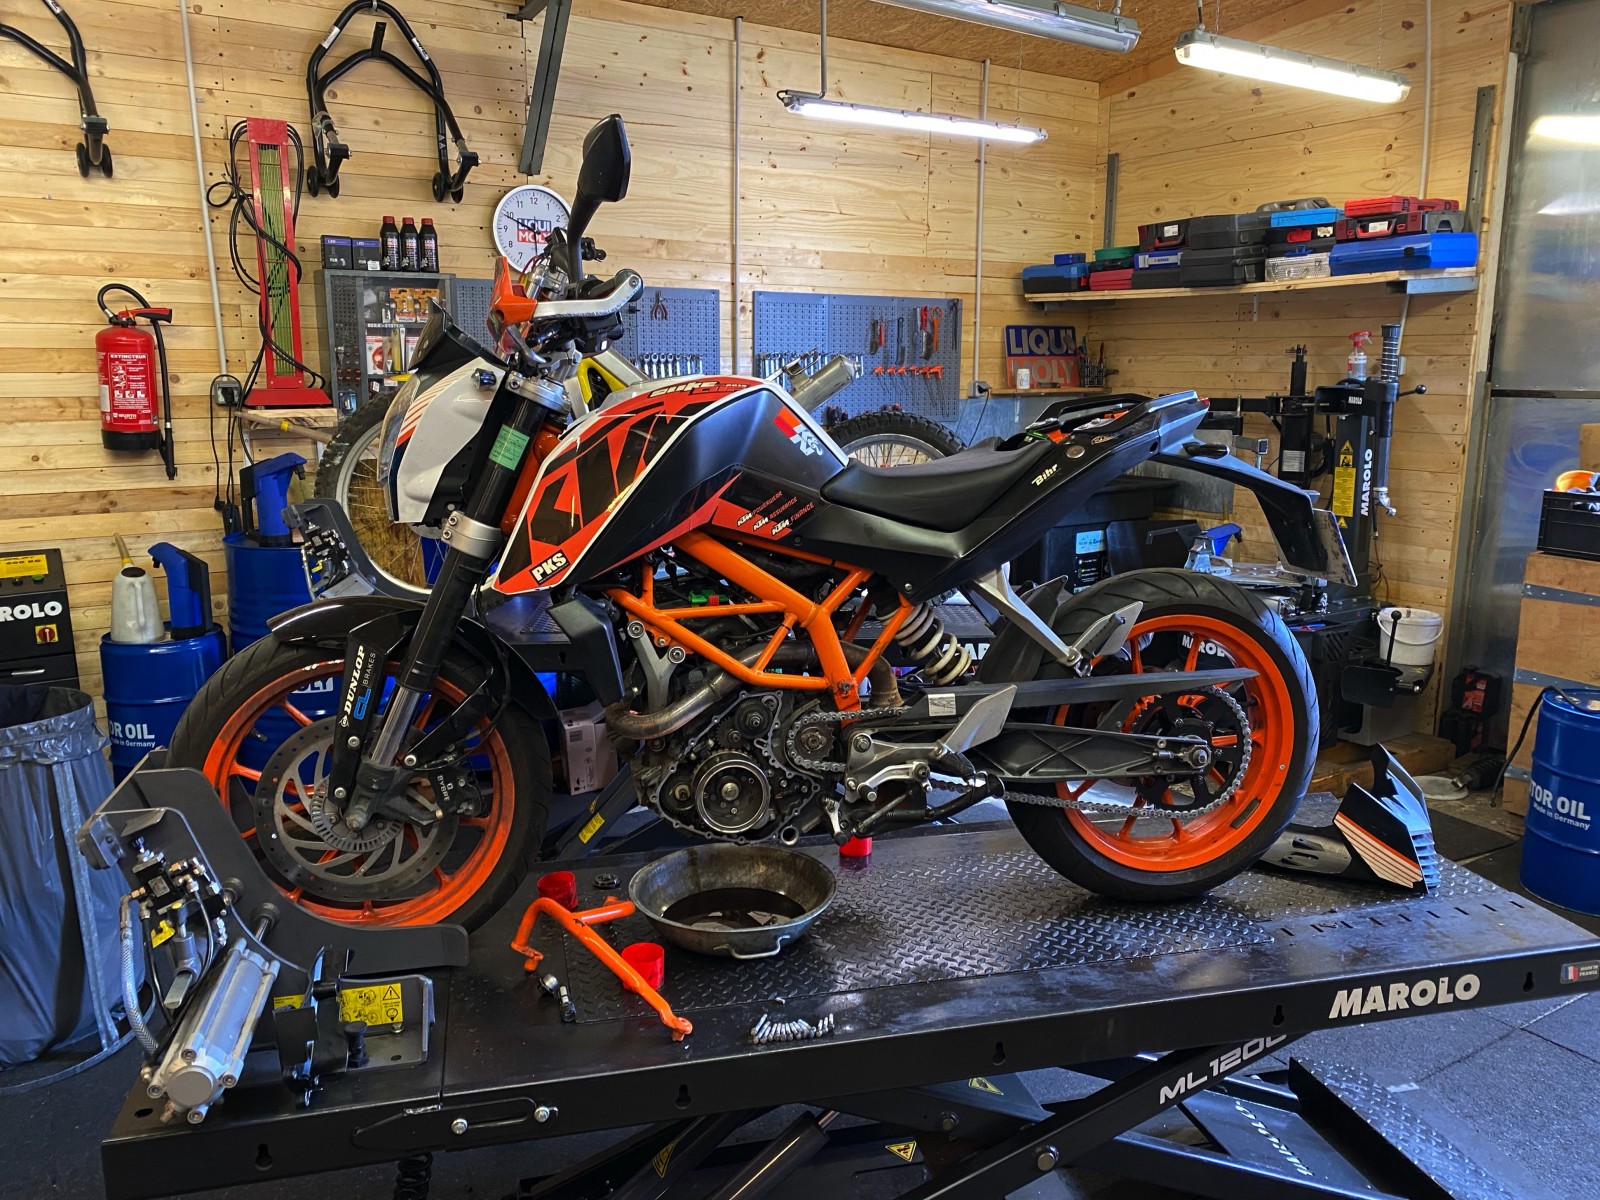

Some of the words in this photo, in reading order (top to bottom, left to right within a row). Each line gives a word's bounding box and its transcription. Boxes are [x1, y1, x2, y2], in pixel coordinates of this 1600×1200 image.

[517, 200, 523, 208] 11
[530, 197, 538, 205] 12
[506, 211, 514, 219] 10
[519, 219, 551, 232] LIQUI
[508, 240, 514, 248] 8
[518, 252, 523, 260] 7
[1008, 328, 1074, 356] LIQUI
[1030, 463, 1059, 487] Bihr
[1360, 448, 1373, 517] MAROLO
[737, 511, 753, 527] KTM
[753, 515, 769, 532] KTM
[771, 518, 790, 536] KTM
[790, 501, 815, 522] FINANCE
[531, 552, 567, 582] PKS
[343, 644, 365, 716] DUNLOP
[362, 652, 377, 687] BRAKES
[353, 688, 372, 721] CL
[124, 723, 156, 740] OIL
[125, 740, 156, 748] Germany
[1556, 796, 1591, 821] OIL
[1546, 810, 1554, 818] in
[1554, 812, 1591, 831] Germany
[1328, 973, 1481, 1020] MAROLO
